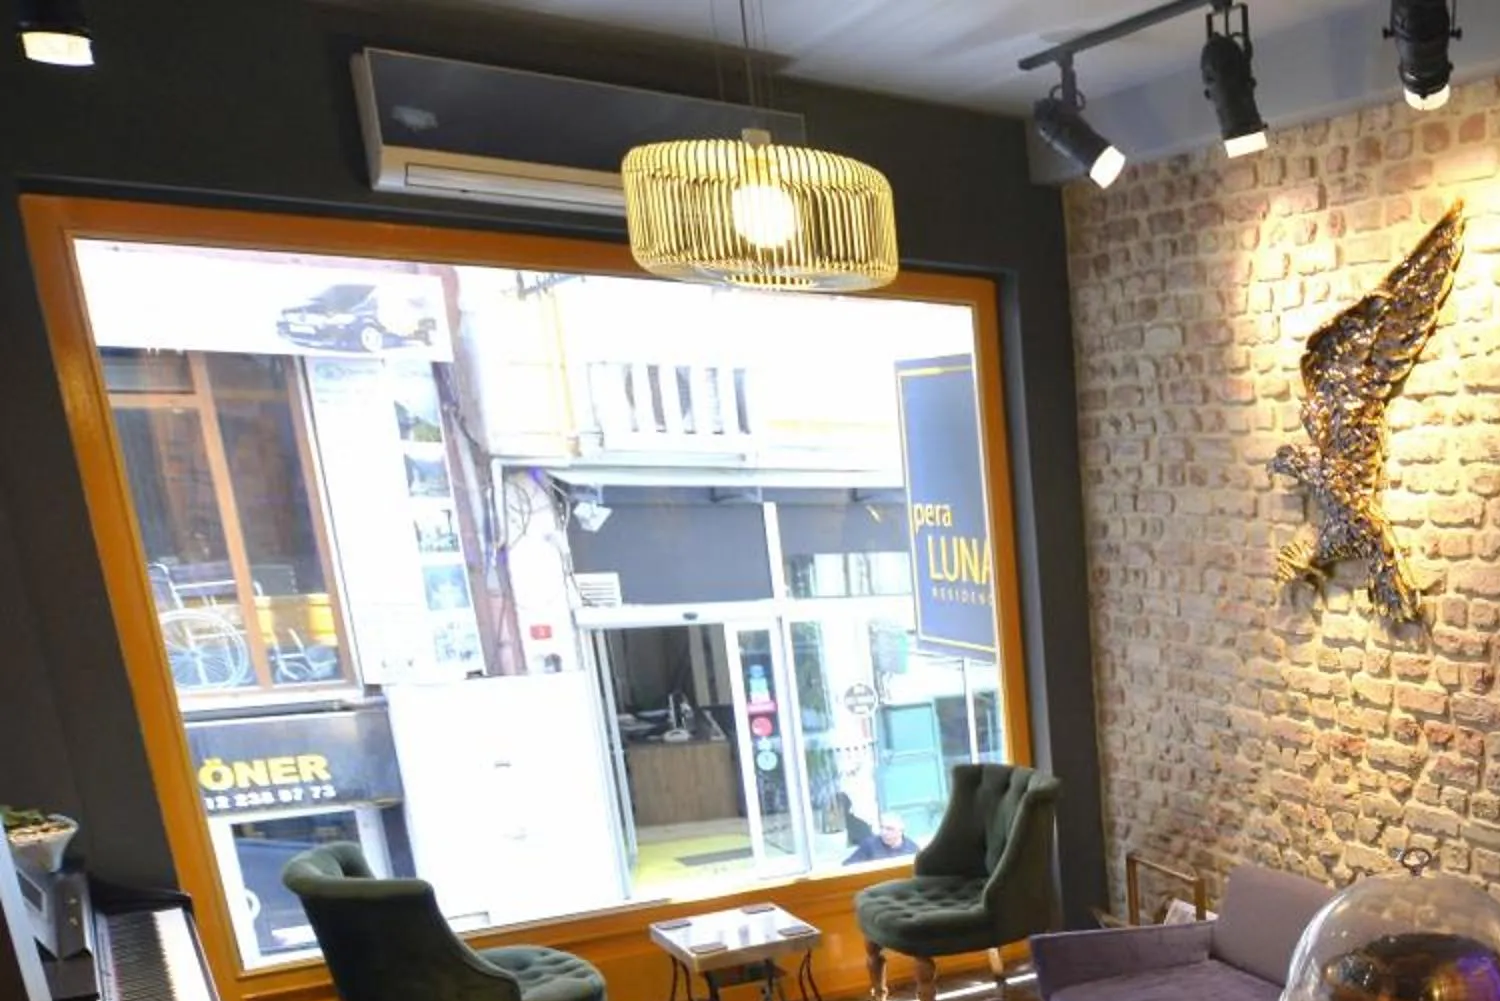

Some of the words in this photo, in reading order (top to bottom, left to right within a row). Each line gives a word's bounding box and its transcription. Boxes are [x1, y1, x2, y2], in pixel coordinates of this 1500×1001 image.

[913, 503, 952, 535] pera
[199, 754, 332, 791] ÖNER
[309, 784, 337, 799] 73
